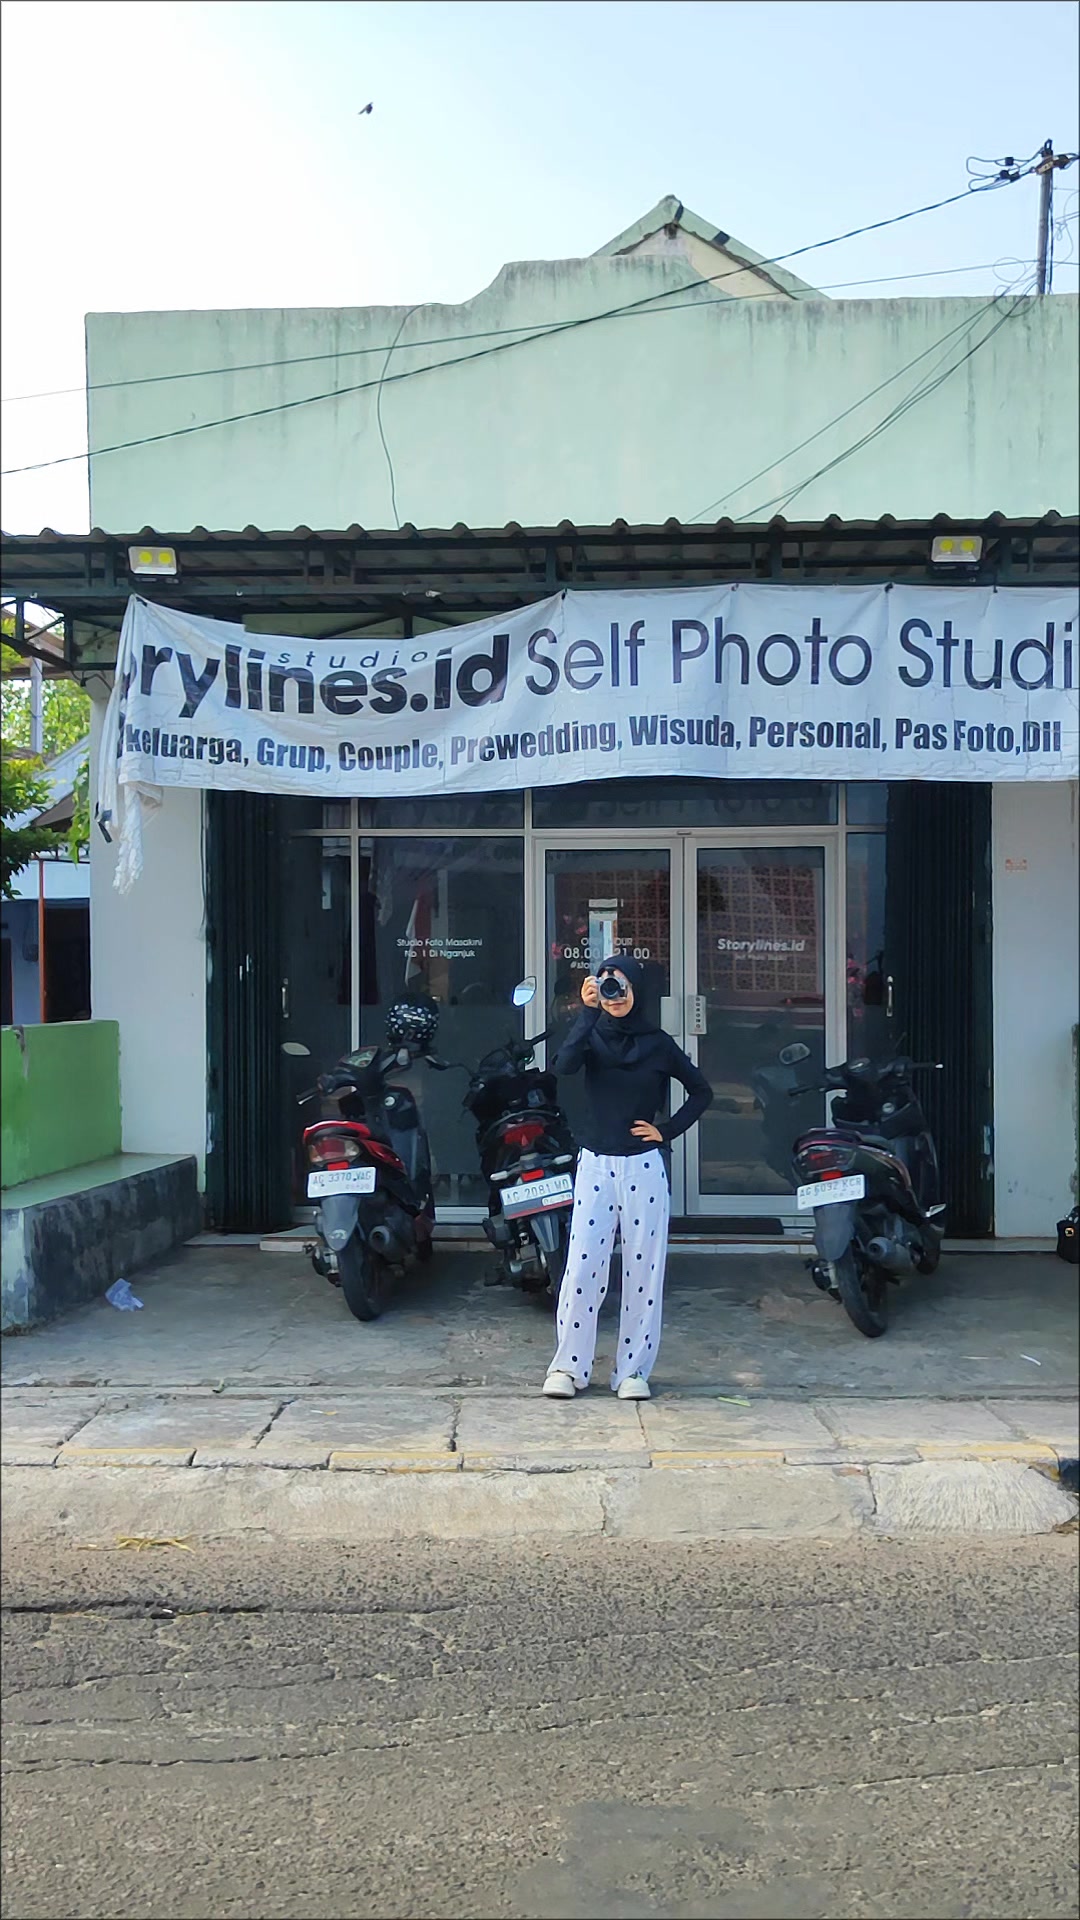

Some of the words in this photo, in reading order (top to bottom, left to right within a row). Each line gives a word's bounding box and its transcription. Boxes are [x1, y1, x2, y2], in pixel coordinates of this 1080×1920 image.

[277, 649, 429, 669] studio
[525, 619, 645, 695] Self
[672, 616, 872, 686] Photo
[898, 617, 1073, 690] Studi
[257, 737, 331, 774] Grup,
[338, 739, 444, 773] Couple,
[451, 720, 623, 765] Prewedding,
[629, 713, 741, 750] Wisuda,
[749, 716, 887, 751] Personal,
[895, 718, 947, 751] Pas
[717, 938, 806, 953] Storylines.id
